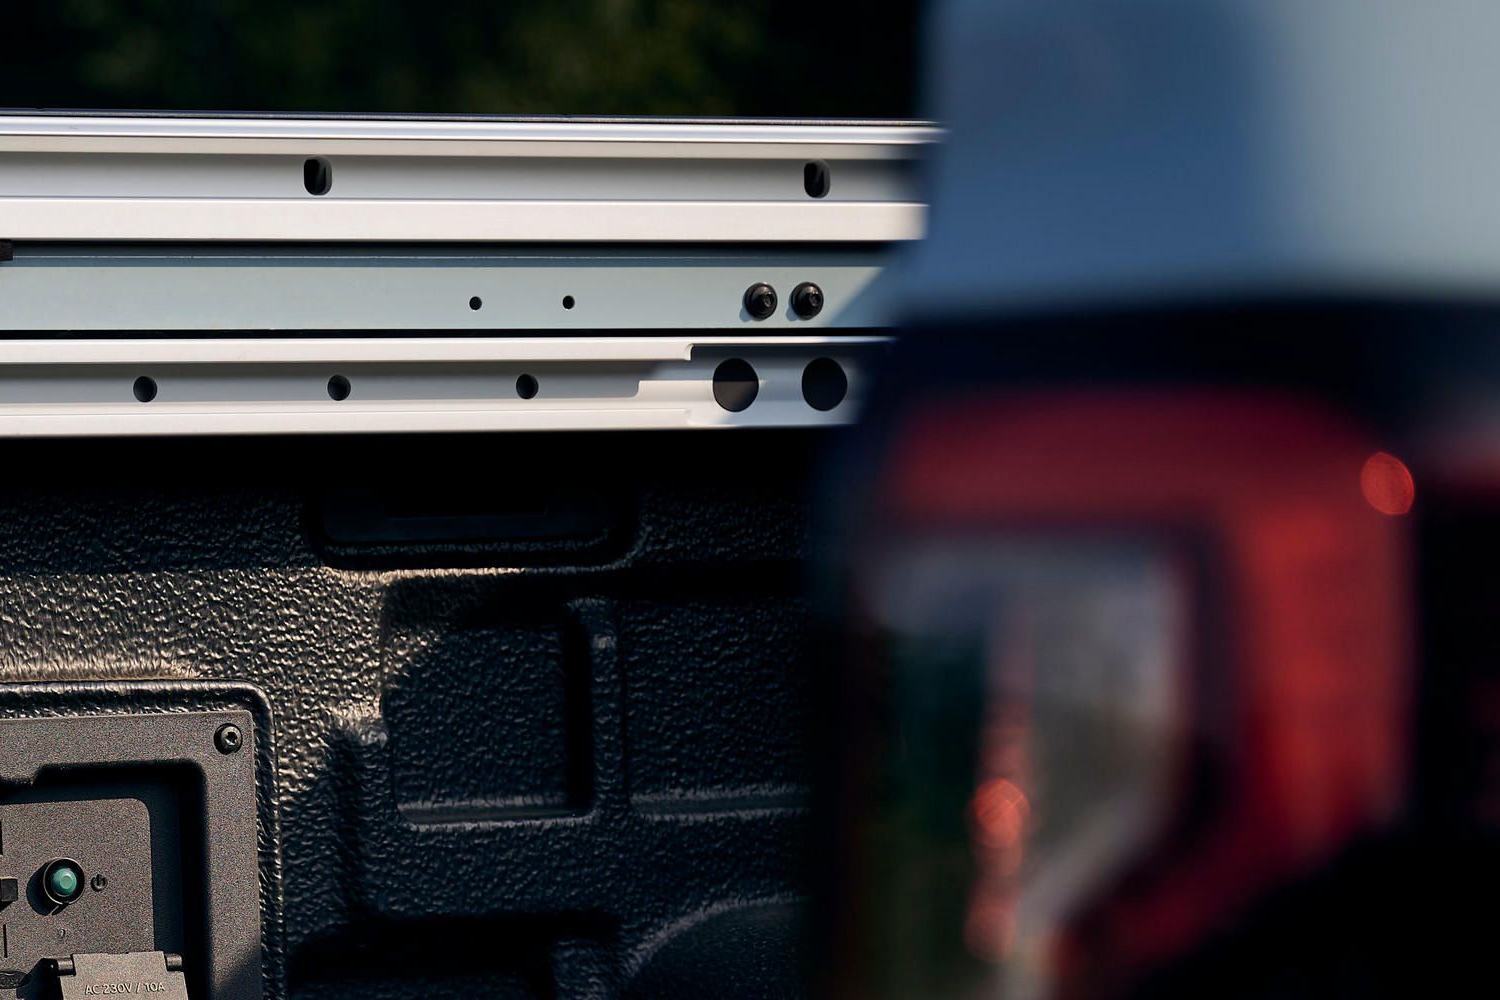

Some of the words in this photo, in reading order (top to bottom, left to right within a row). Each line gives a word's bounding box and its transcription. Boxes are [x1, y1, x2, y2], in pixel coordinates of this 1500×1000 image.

[85, 984, 100, 995] AC
[102, 983, 132, 994] 230V
[144, 982, 166, 993] 10A
